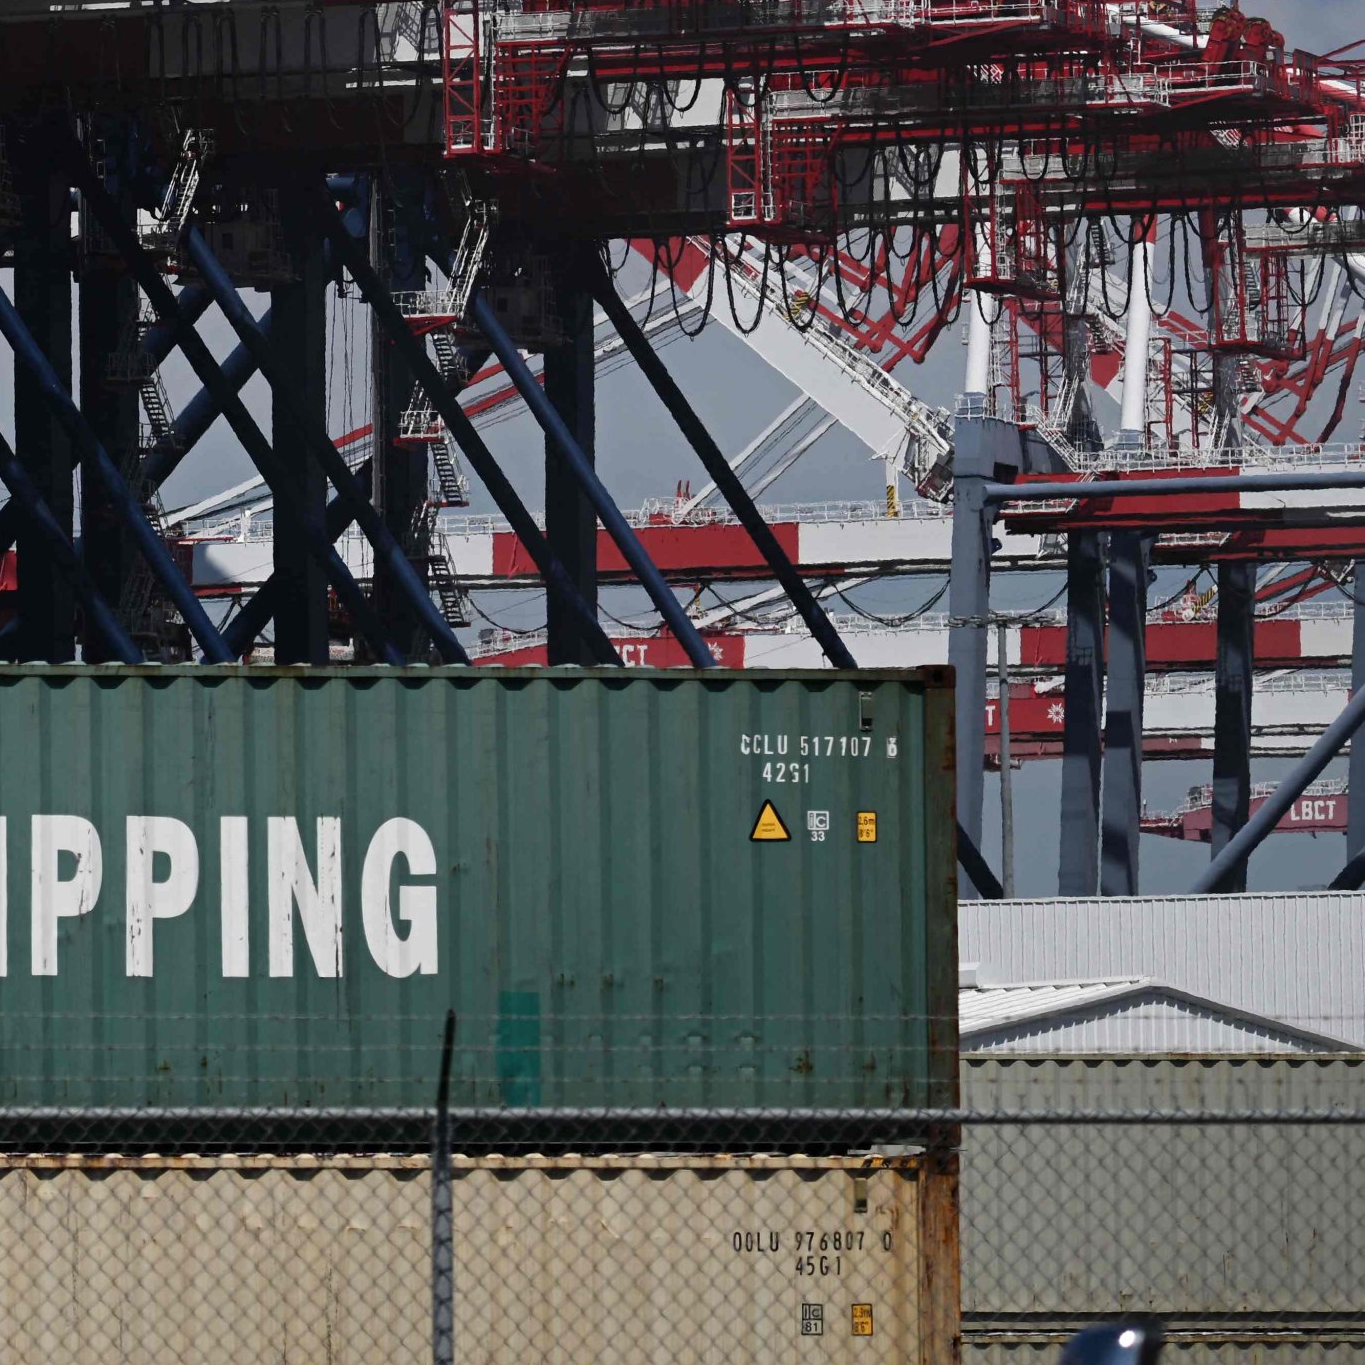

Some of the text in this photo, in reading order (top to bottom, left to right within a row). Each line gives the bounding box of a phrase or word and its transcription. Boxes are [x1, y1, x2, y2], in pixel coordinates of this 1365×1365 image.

[741, 734, 788, 755] CCLU
[800, 736, 872, 757] 517107
[1290, 800, 1337, 822] LBCT
[810, 831, 826, 842] 33
[795, 1232, 865, 1252] 976807
[795, 1256, 842, 1276] 45G1
[805, 1322, 819, 1333] 81
